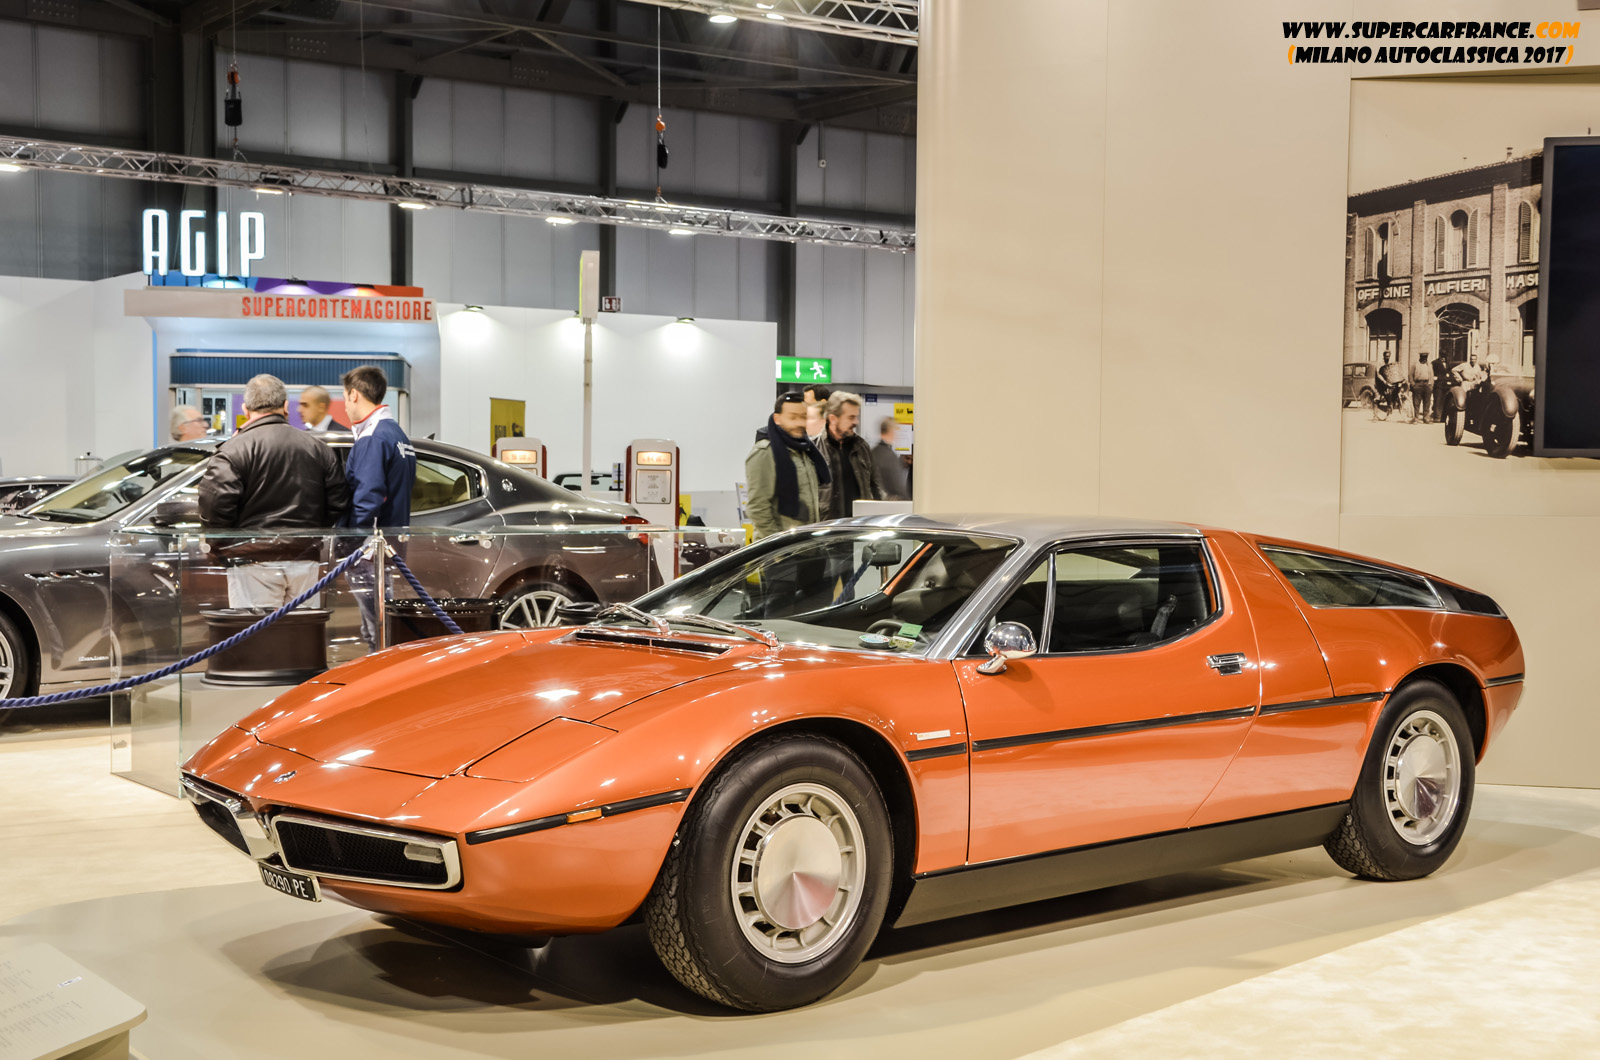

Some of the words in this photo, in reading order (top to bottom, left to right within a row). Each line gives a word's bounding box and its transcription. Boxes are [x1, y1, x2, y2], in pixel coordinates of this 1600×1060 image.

[142, 209, 265, 278] AGIP
[1426, 278, 1487, 295] ALFIERI
[242, 296, 432, 320] SUPERCORTEMAGGIORE
[292, 878, 309, 897] PE
